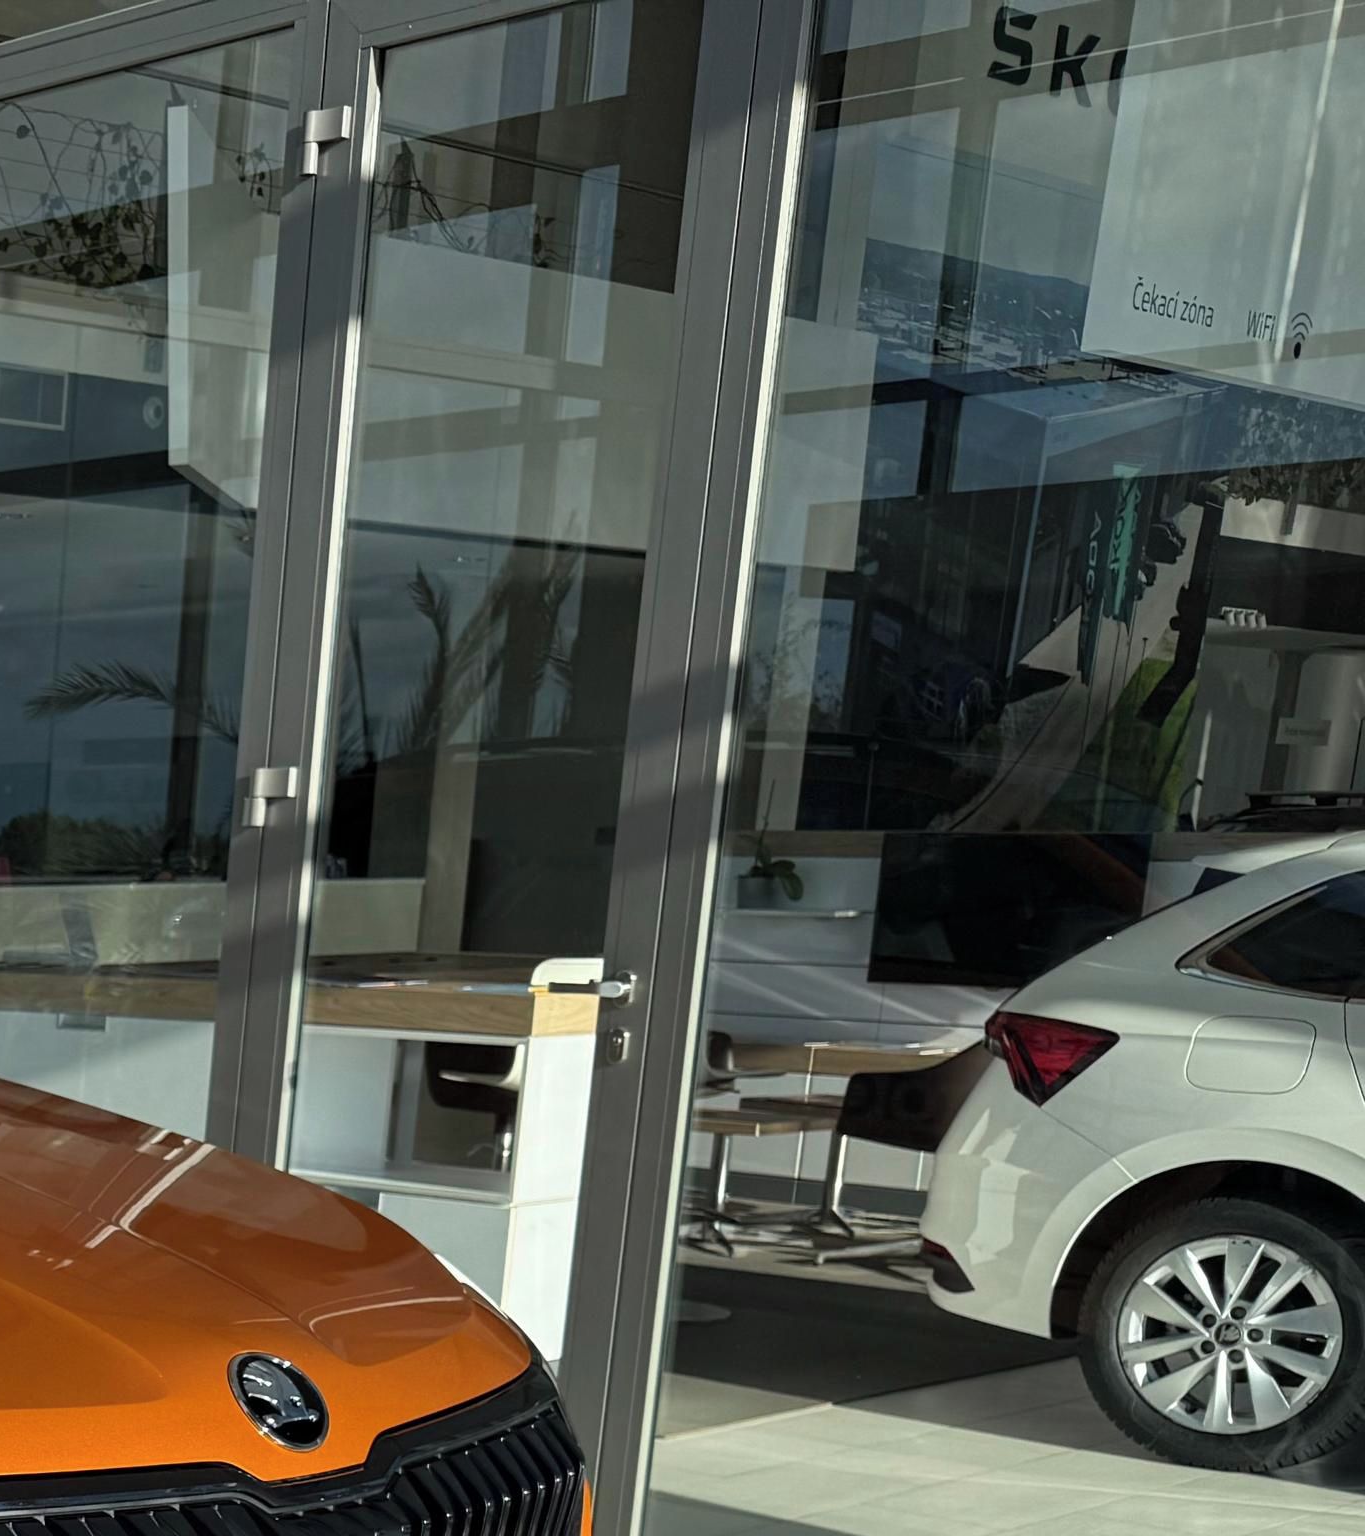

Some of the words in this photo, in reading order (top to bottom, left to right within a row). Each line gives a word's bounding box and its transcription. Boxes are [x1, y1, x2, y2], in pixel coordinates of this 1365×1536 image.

[1132, 276, 1180, 321] Čekací
[1180, 295, 1215, 328] zóna
[1246, 310, 1277, 342] WiFi
